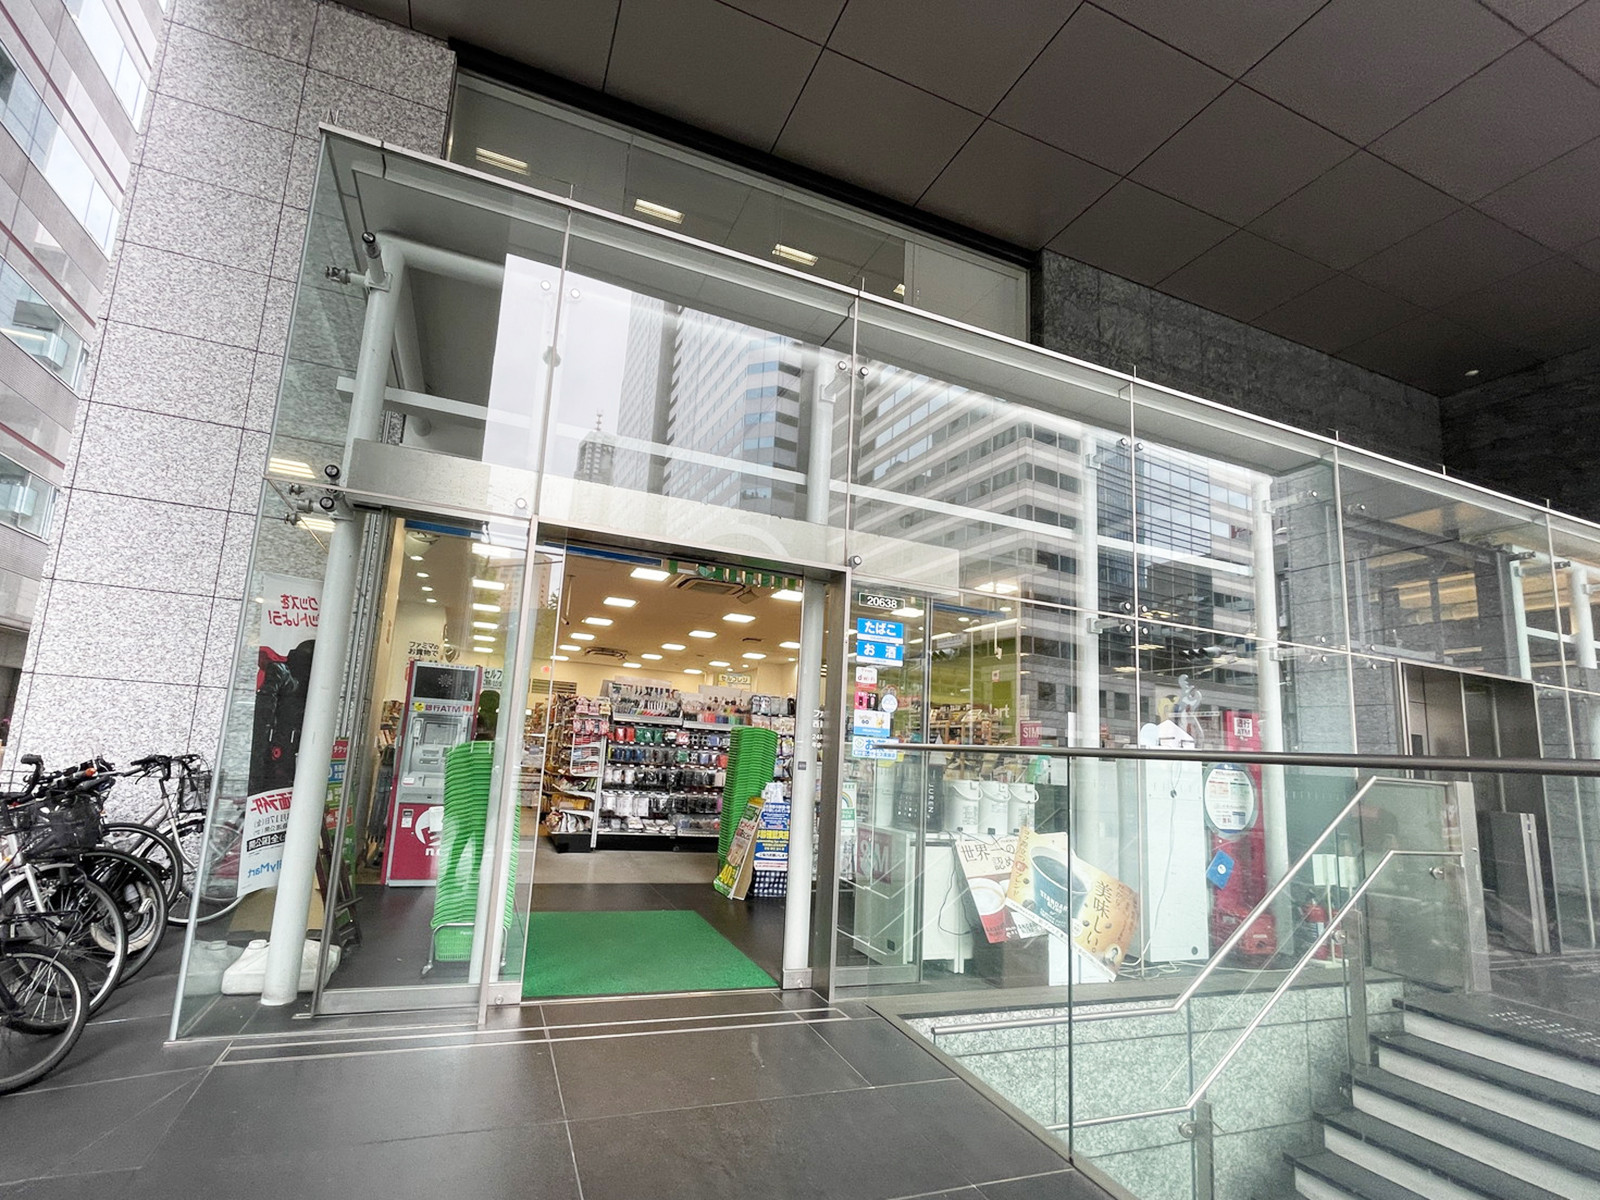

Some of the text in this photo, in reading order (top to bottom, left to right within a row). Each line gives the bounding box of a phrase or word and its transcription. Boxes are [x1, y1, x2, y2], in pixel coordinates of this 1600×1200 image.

[866, 595, 898, 609] 20638
[864, 620, 897, 636] たばこ
[408, 641, 440, 650] ファミマの
[1022, 726, 1041, 738] SIM
[960, 843, 1016, 863] 世界一の
